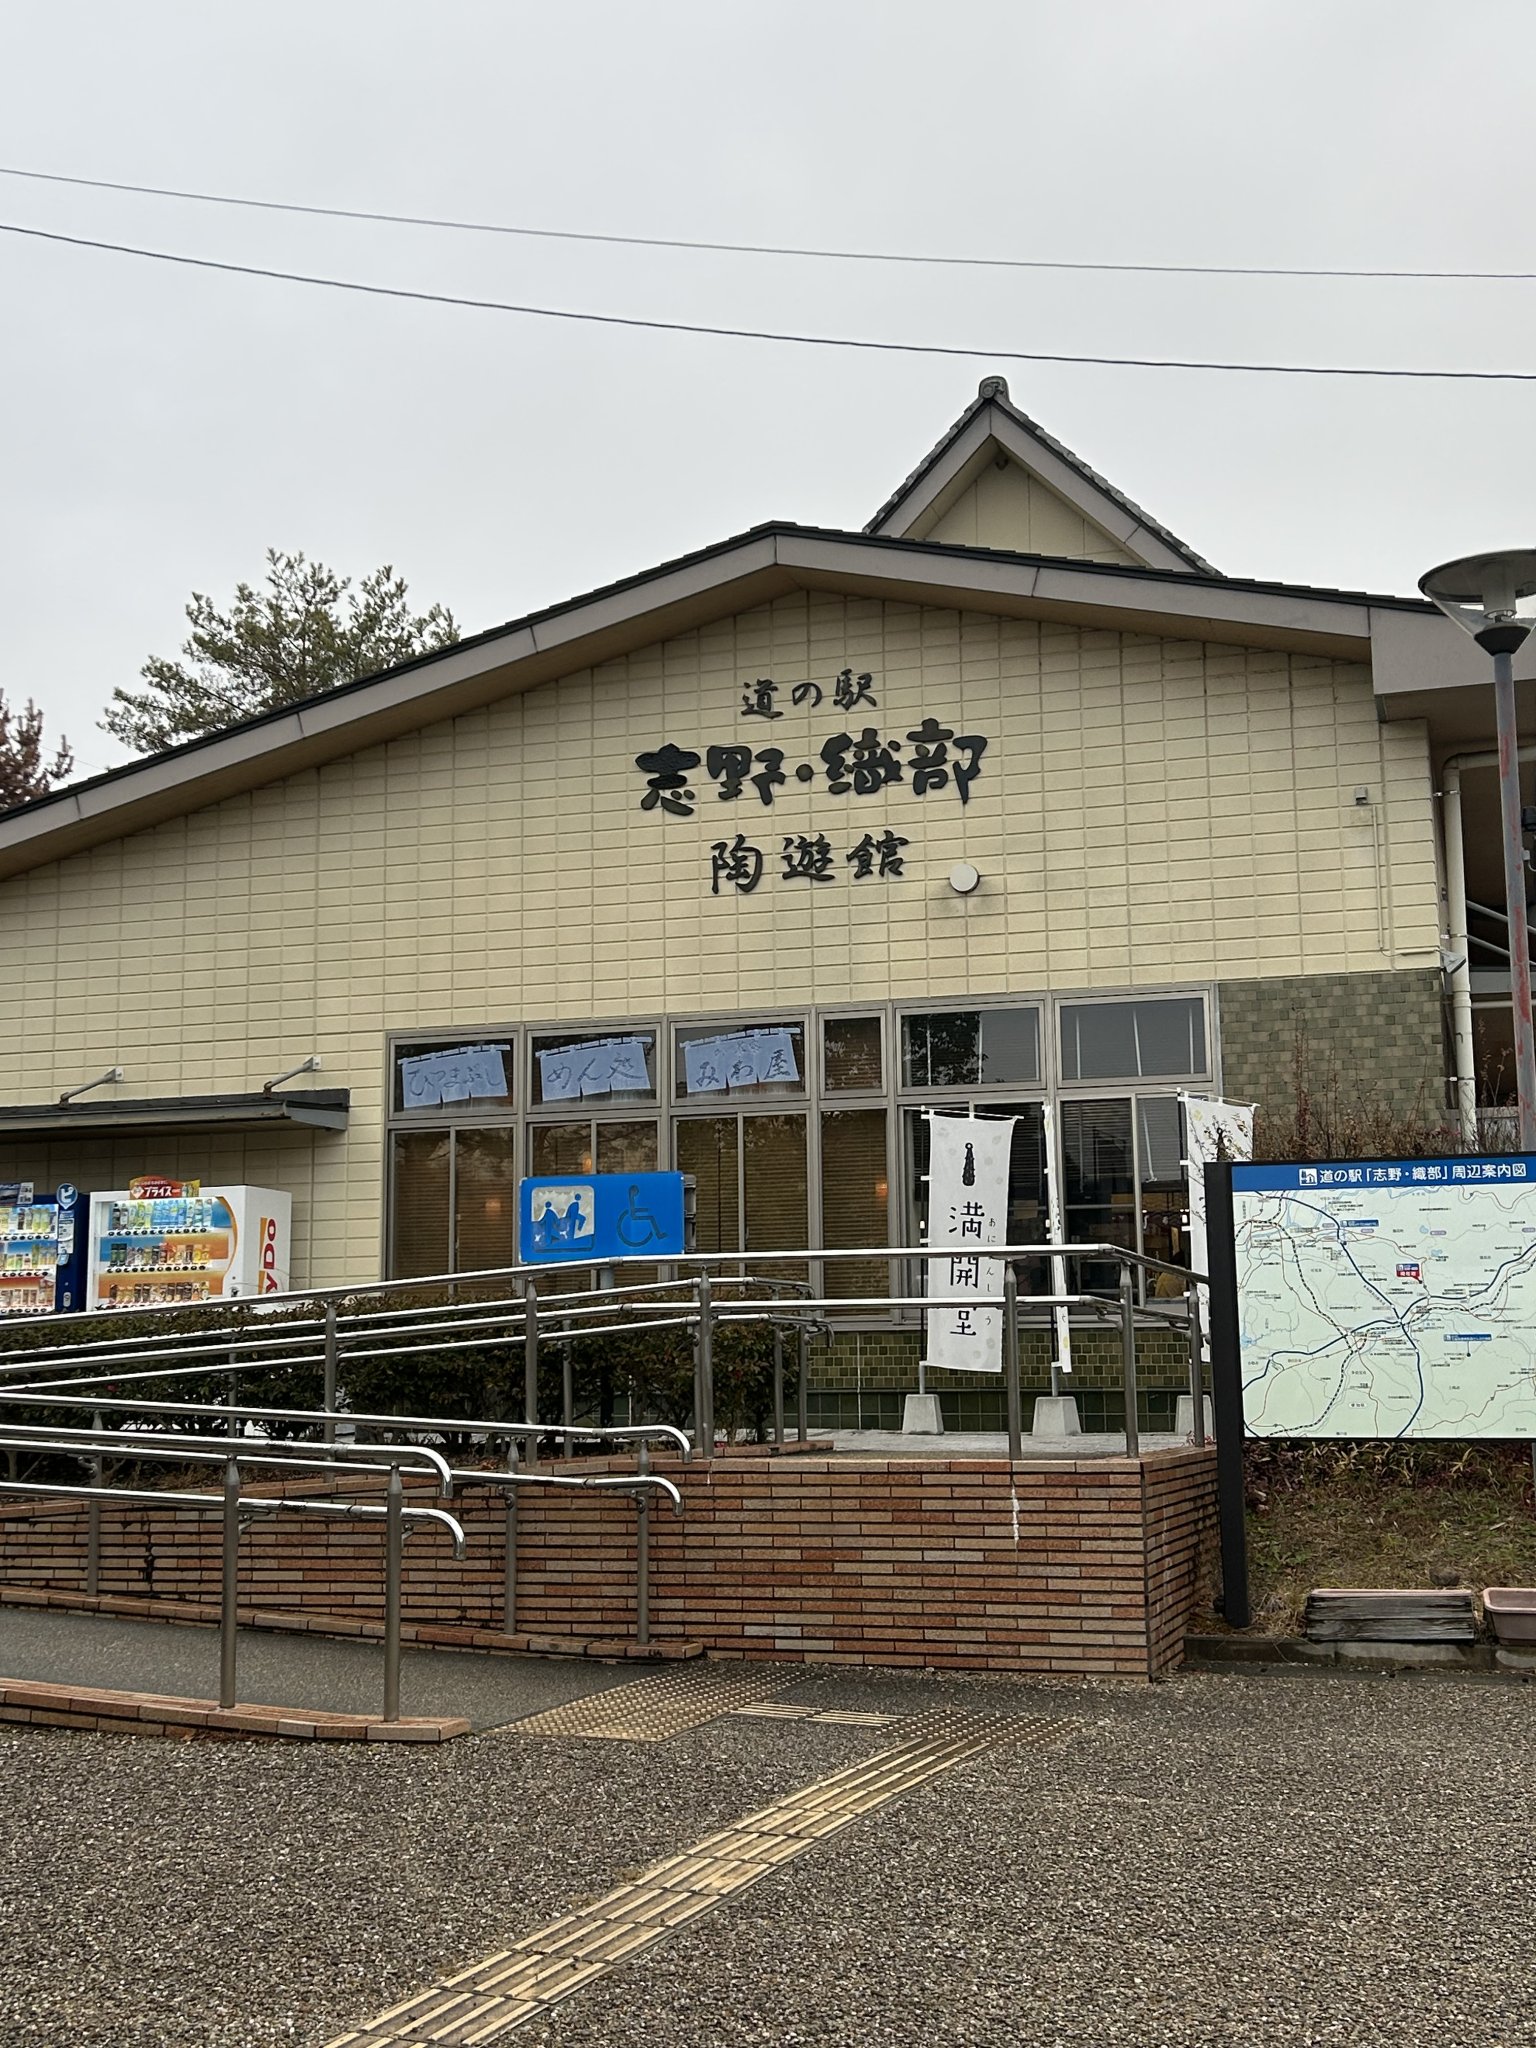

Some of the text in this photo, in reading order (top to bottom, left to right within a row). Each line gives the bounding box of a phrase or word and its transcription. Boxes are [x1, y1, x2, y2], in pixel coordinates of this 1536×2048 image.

[741, 668, 877, 719] 道の駅
[635, 718, 987, 816] 志野・織部
[711, 829, 909, 894] 陶遊館
[407, 1062, 501, 1096] ひつまぶし
[546, 1052, 645, 1089] めん処
[1320, 1163, 1527, 1183] 道の駅「志野・織部」周辺案内図
